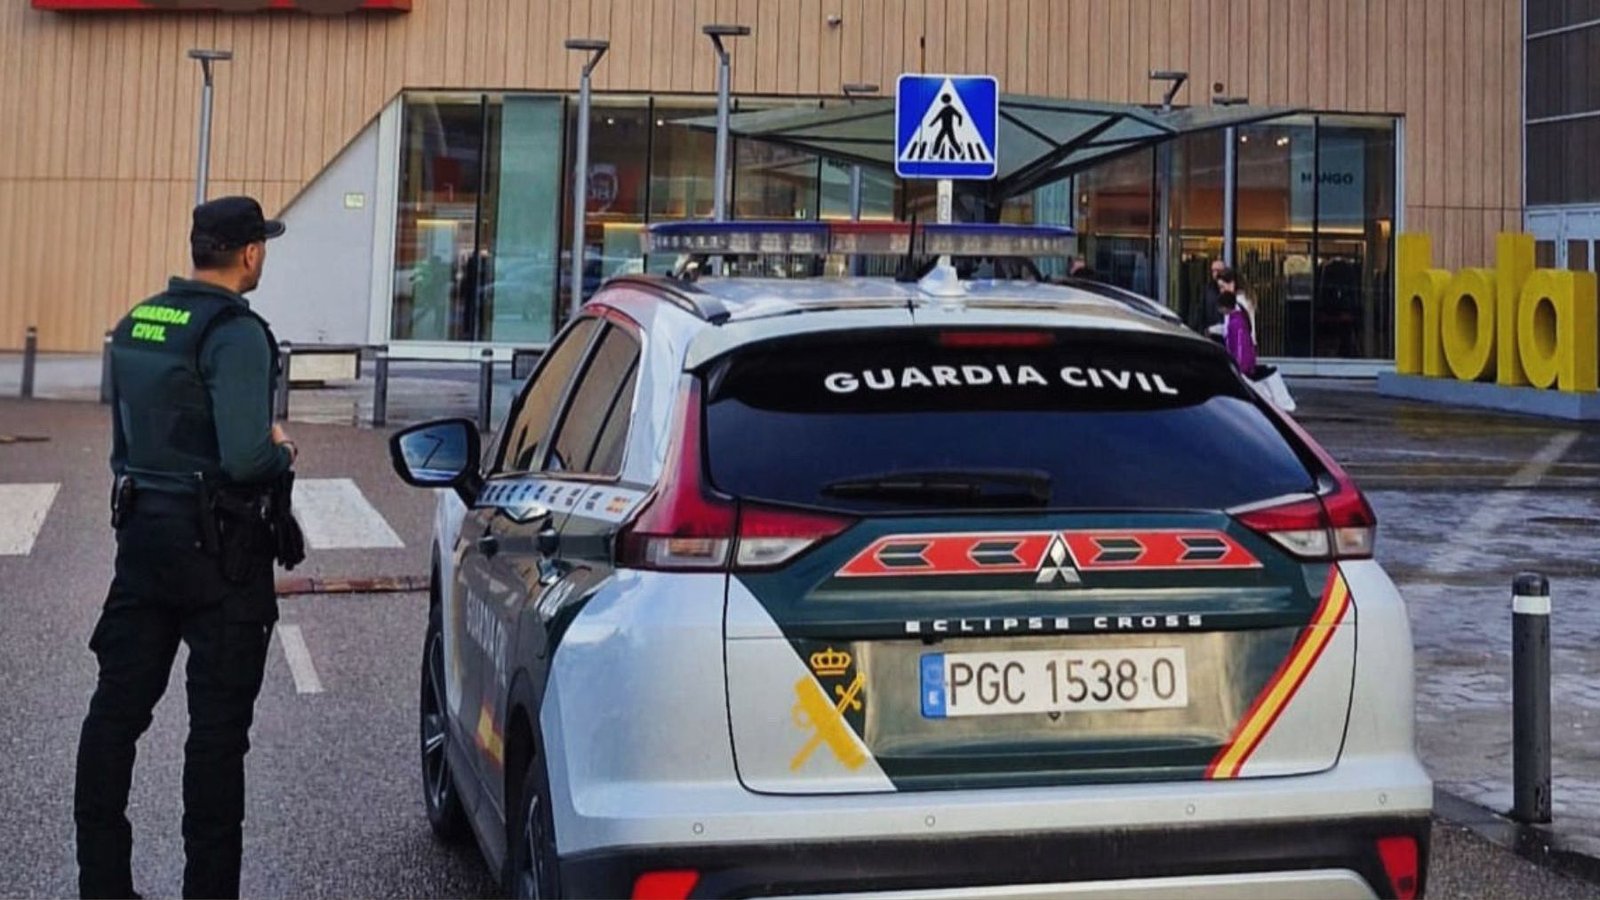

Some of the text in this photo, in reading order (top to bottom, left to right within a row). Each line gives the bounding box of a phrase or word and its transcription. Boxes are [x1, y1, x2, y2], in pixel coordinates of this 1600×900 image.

[1395, 232, 1597, 391] hola
[131, 323, 166, 341] CIVIL
[824, 365, 1179, 395] GUARDIA CIVIL
[905, 614, 1203, 633] ECLIPSE CROSS
[950, 661, 1026, 706] PGC
[1046, 658, 1139, 704] 1538
